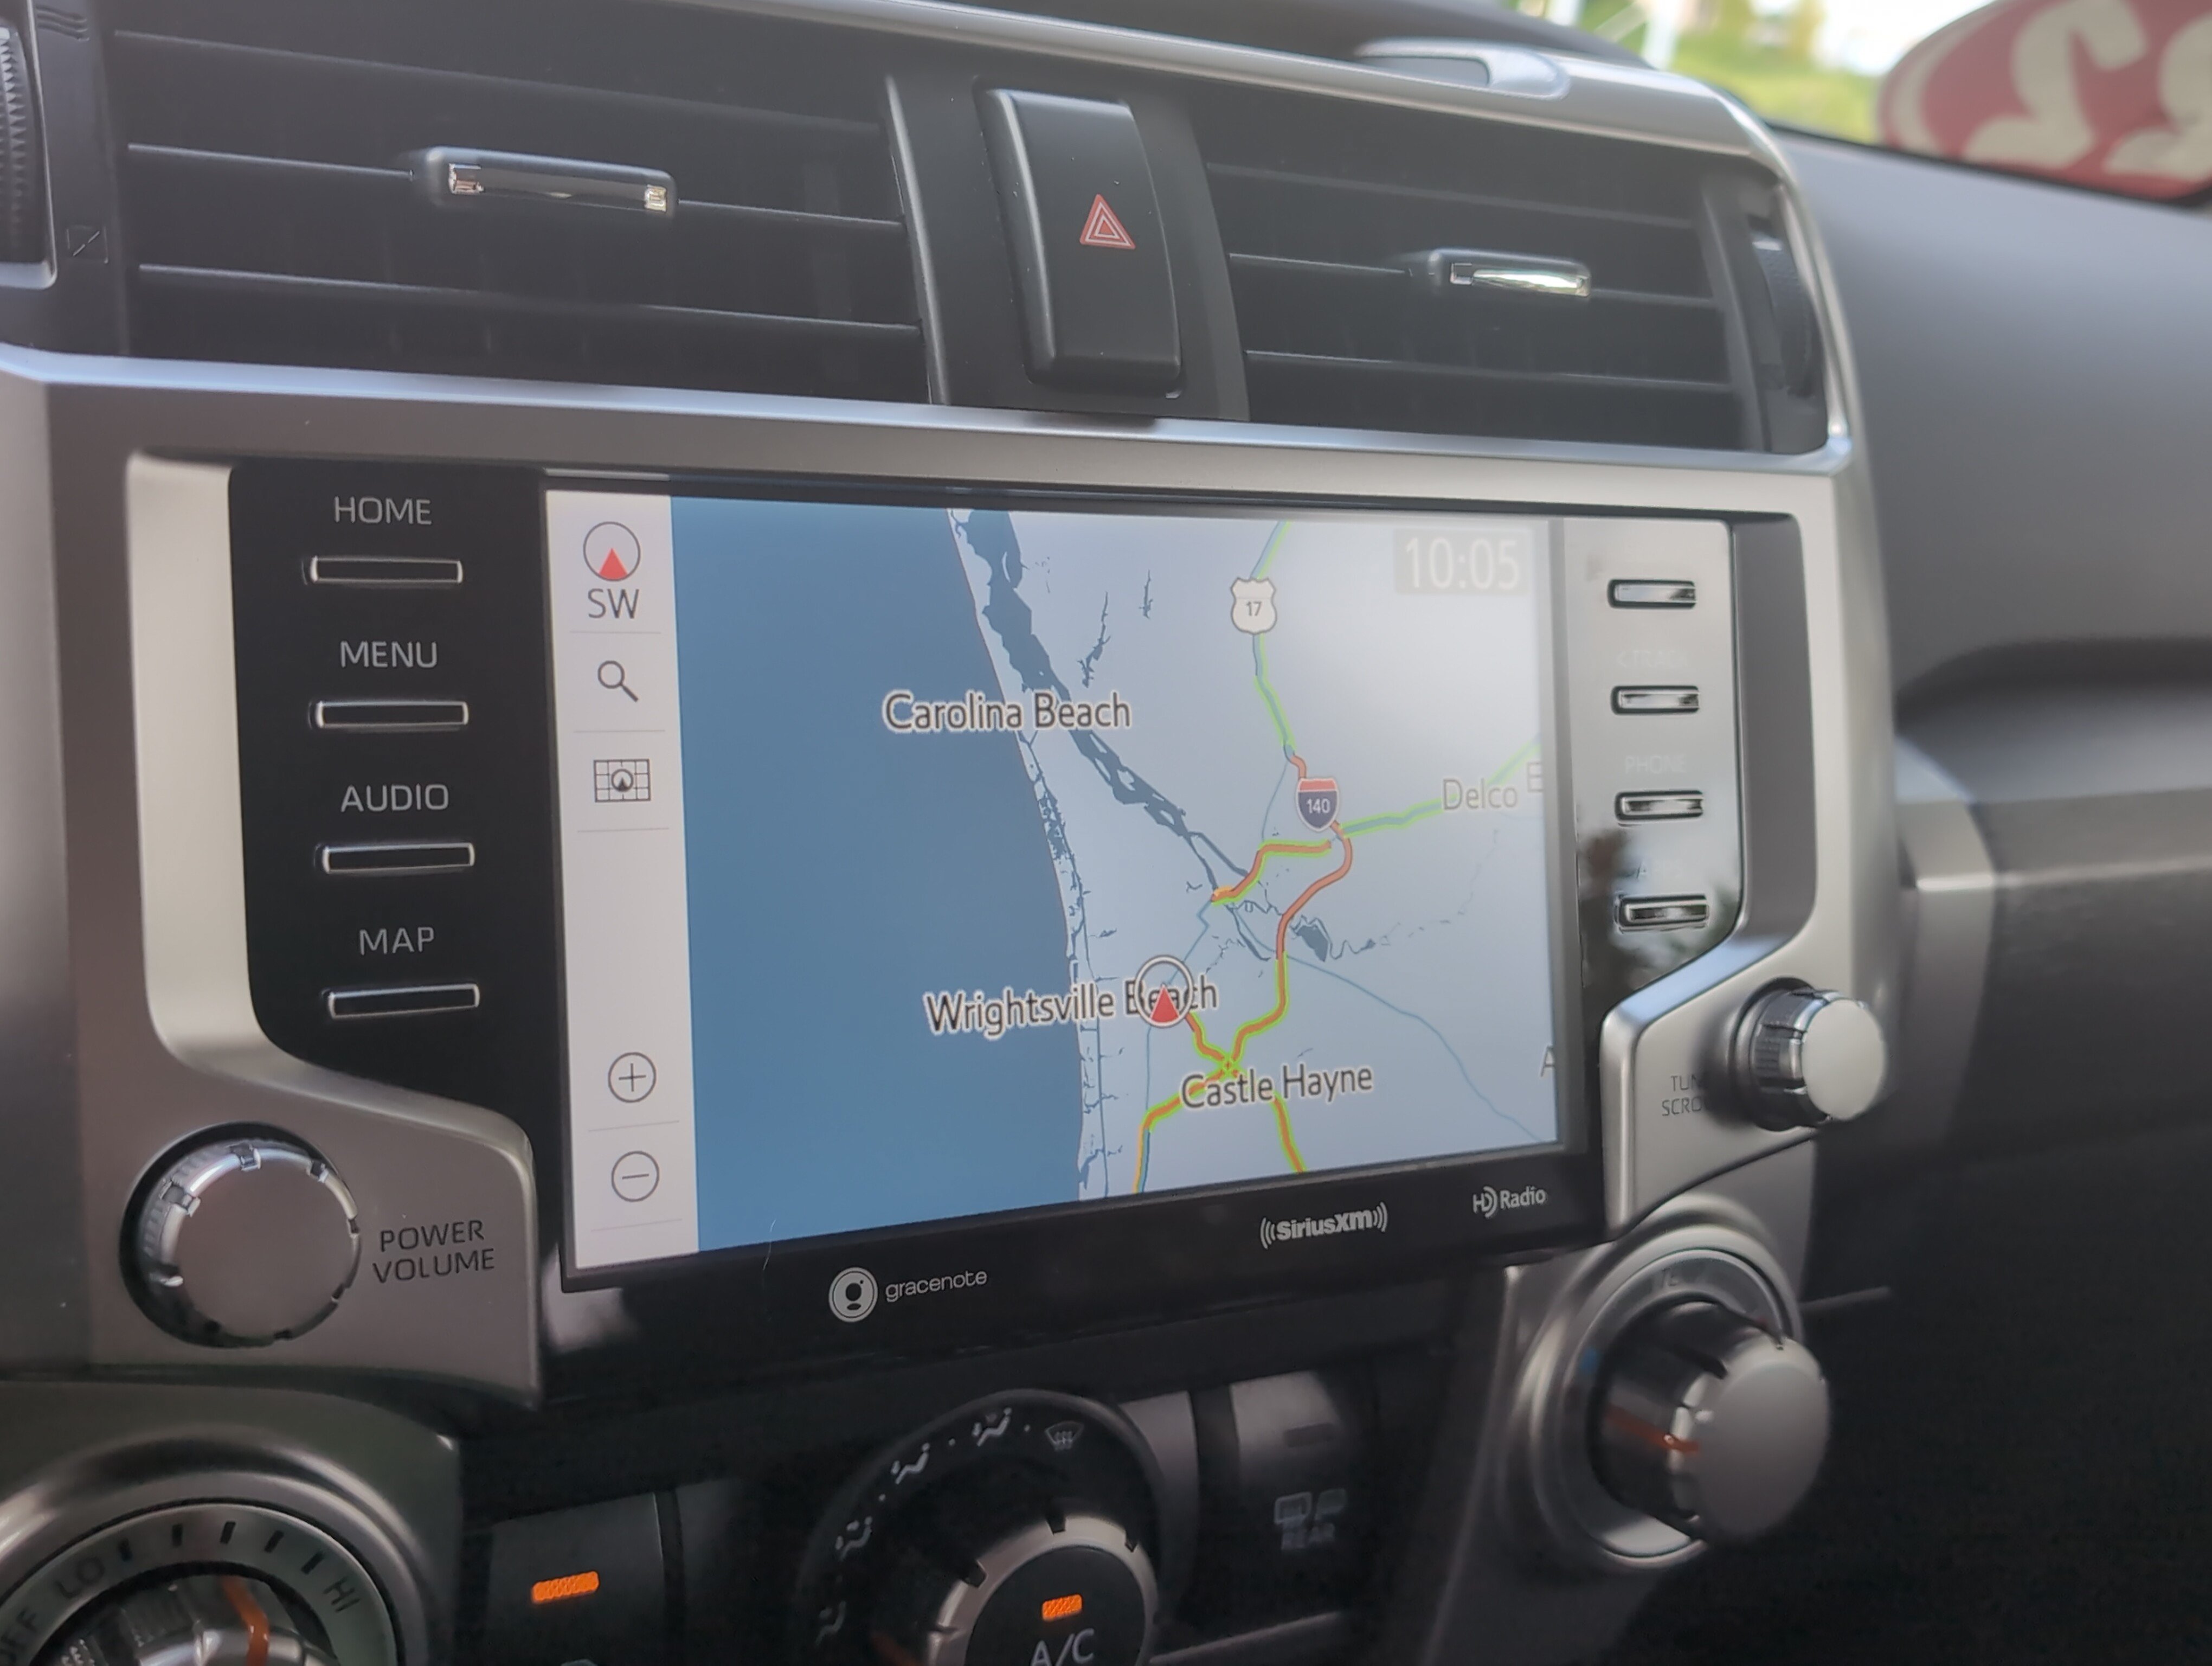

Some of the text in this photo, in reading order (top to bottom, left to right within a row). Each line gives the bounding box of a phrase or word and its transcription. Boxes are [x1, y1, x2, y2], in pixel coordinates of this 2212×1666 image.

[334, 496, 433, 525] HOME
[1405, 537, 1519, 590] 10:05
[587, 588, 640, 619] SW
[1246, 601, 1262, 617] 17
[340, 640, 438, 668] MENU
[885, 692, 1130, 729] Carolina Beach
[1625, 753, 1687, 774] PHONE
[340, 784, 449, 812] AUDIO
[1306, 798, 1331, 814] 140
[1442, 779, 1518, 810] Delco
[358, 927, 435, 955] MAP
[926, 983, 1115, 1037] Wrightsville
[1181, 1063, 1373, 1108] Castle Hayne
[1662, 1096, 1707, 1117] SCRO
[1500, 1186, 1546, 1210] Radio
[381, 1219, 484, 1252] POWER
[372, 1248, 495, 1284] VOLUME
[885, 1271, 988, 1303] gracenote
[55, 1555, 106, 1599] LO
[323, 1575, 361, 1614] HI
[1030, 1627, 1095, 1666] A/C
